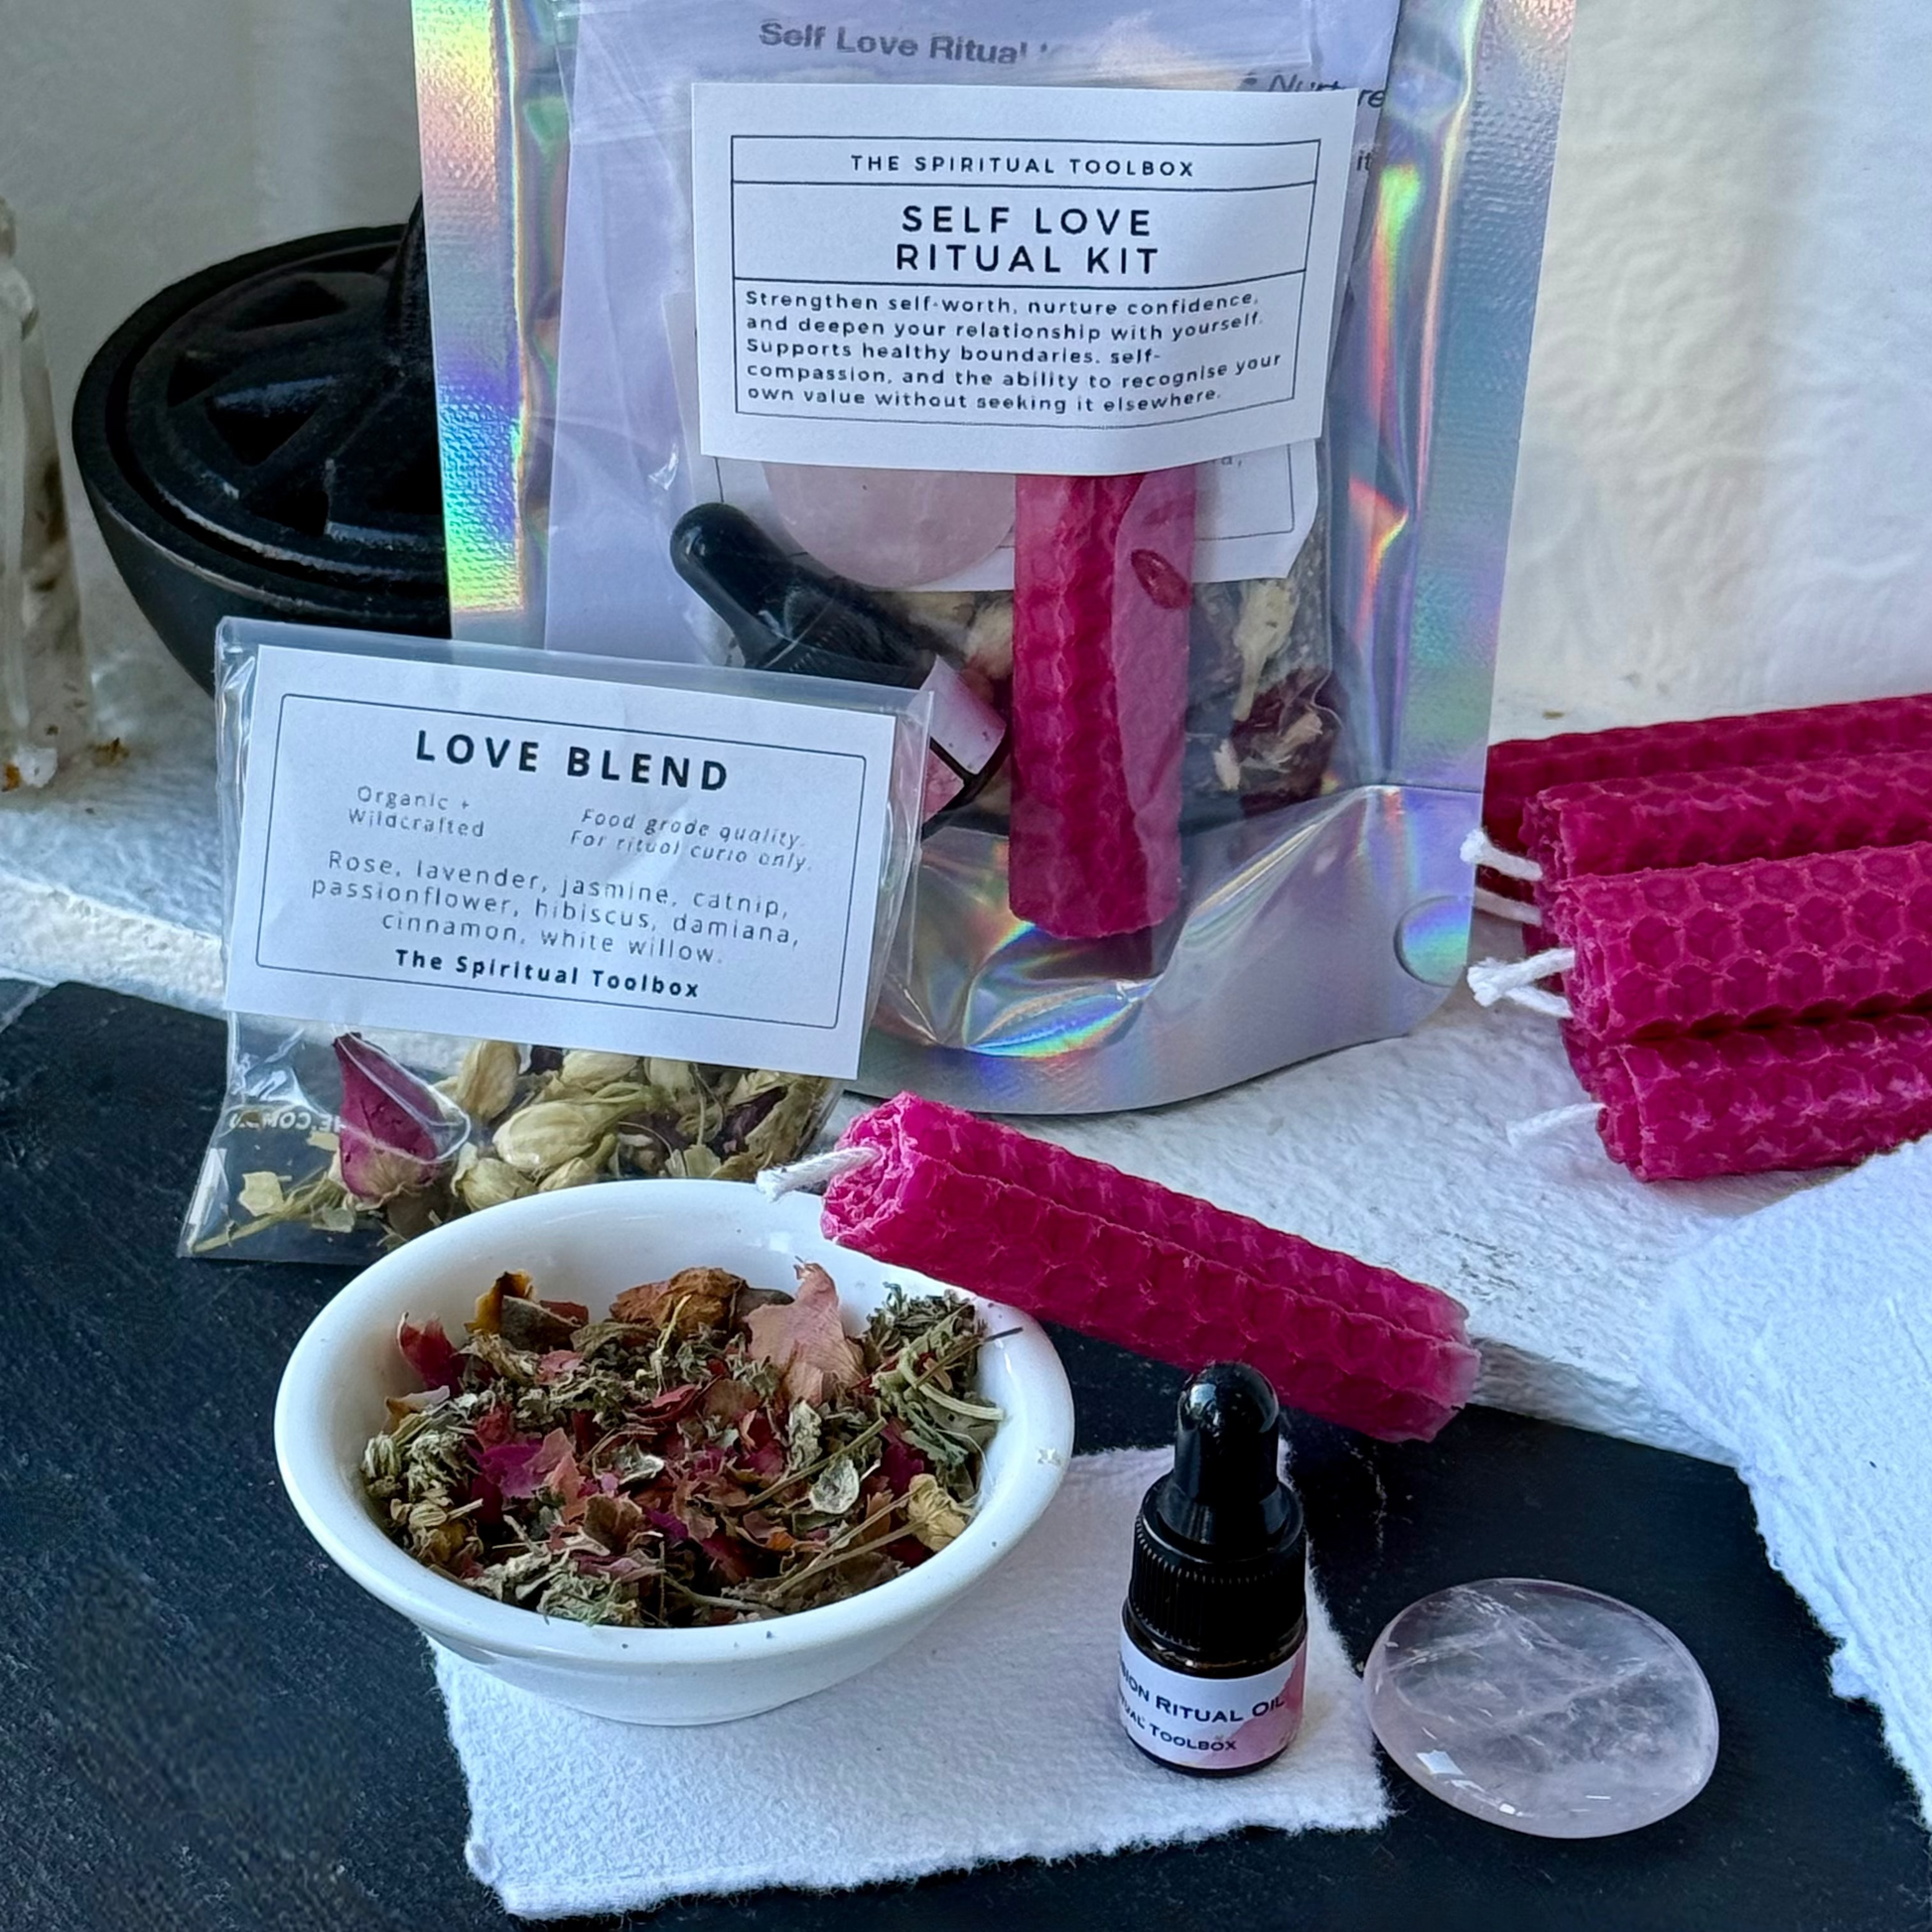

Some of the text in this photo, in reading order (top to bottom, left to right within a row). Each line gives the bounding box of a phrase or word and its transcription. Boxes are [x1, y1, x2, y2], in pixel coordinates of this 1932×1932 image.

[759, 20, 826, 49] Self
[837, 26, 918, 57] Love
[929, 34, 1028, 65] Ritual
[851, 155, 1193, 177] THE SPIRITUAL TOOLBOX
[901, 205, 1151, 236] SELF LOVE
[897, 243, 1159, 274] RITUAL KIT
[746, 290, 1259, 315] Strengthen self-worth, nurture confidence,
[747, 311, 1263, 344] and deepen your relationship with yourself.
[747, 338, 852, 358] Supports
[862, 343, 950, 364] healthy
[1110, 347, 1162, 364] self-
[747, 352, 1282, 391] compassion, and the ability to recognise your
[748, 387, 1221, 415] own value without seeking it elsewhere.
[416, 730, 728, 791] LOVE BLEND
[357, 785, 449, 811] Organic
[348, 807, 484, 838] Wildcrafted
[581, 807, 636, 830] Food
[643, 817, 709, 838] grade
[570, 829, 608, 848] For
[616, 836, 680, 856] ritual
[689, 844, 748, 864] curio
[329, 850, 788, 919] Rose, lavender, jasmine, catnip,
[311, 878, 799, 947] passionflower, hibiscus, damiana,
[382, 910, 724, 964] cinnamon, white willow.
[395, 948, 699, 998] The Spiritual Toolbox
[1156, 1695, 1243, 1724] RITUAL
[1252, 1696, 1285, 1718] OIL
[1149, 1723, 1237, 1751] TOOLBOX
